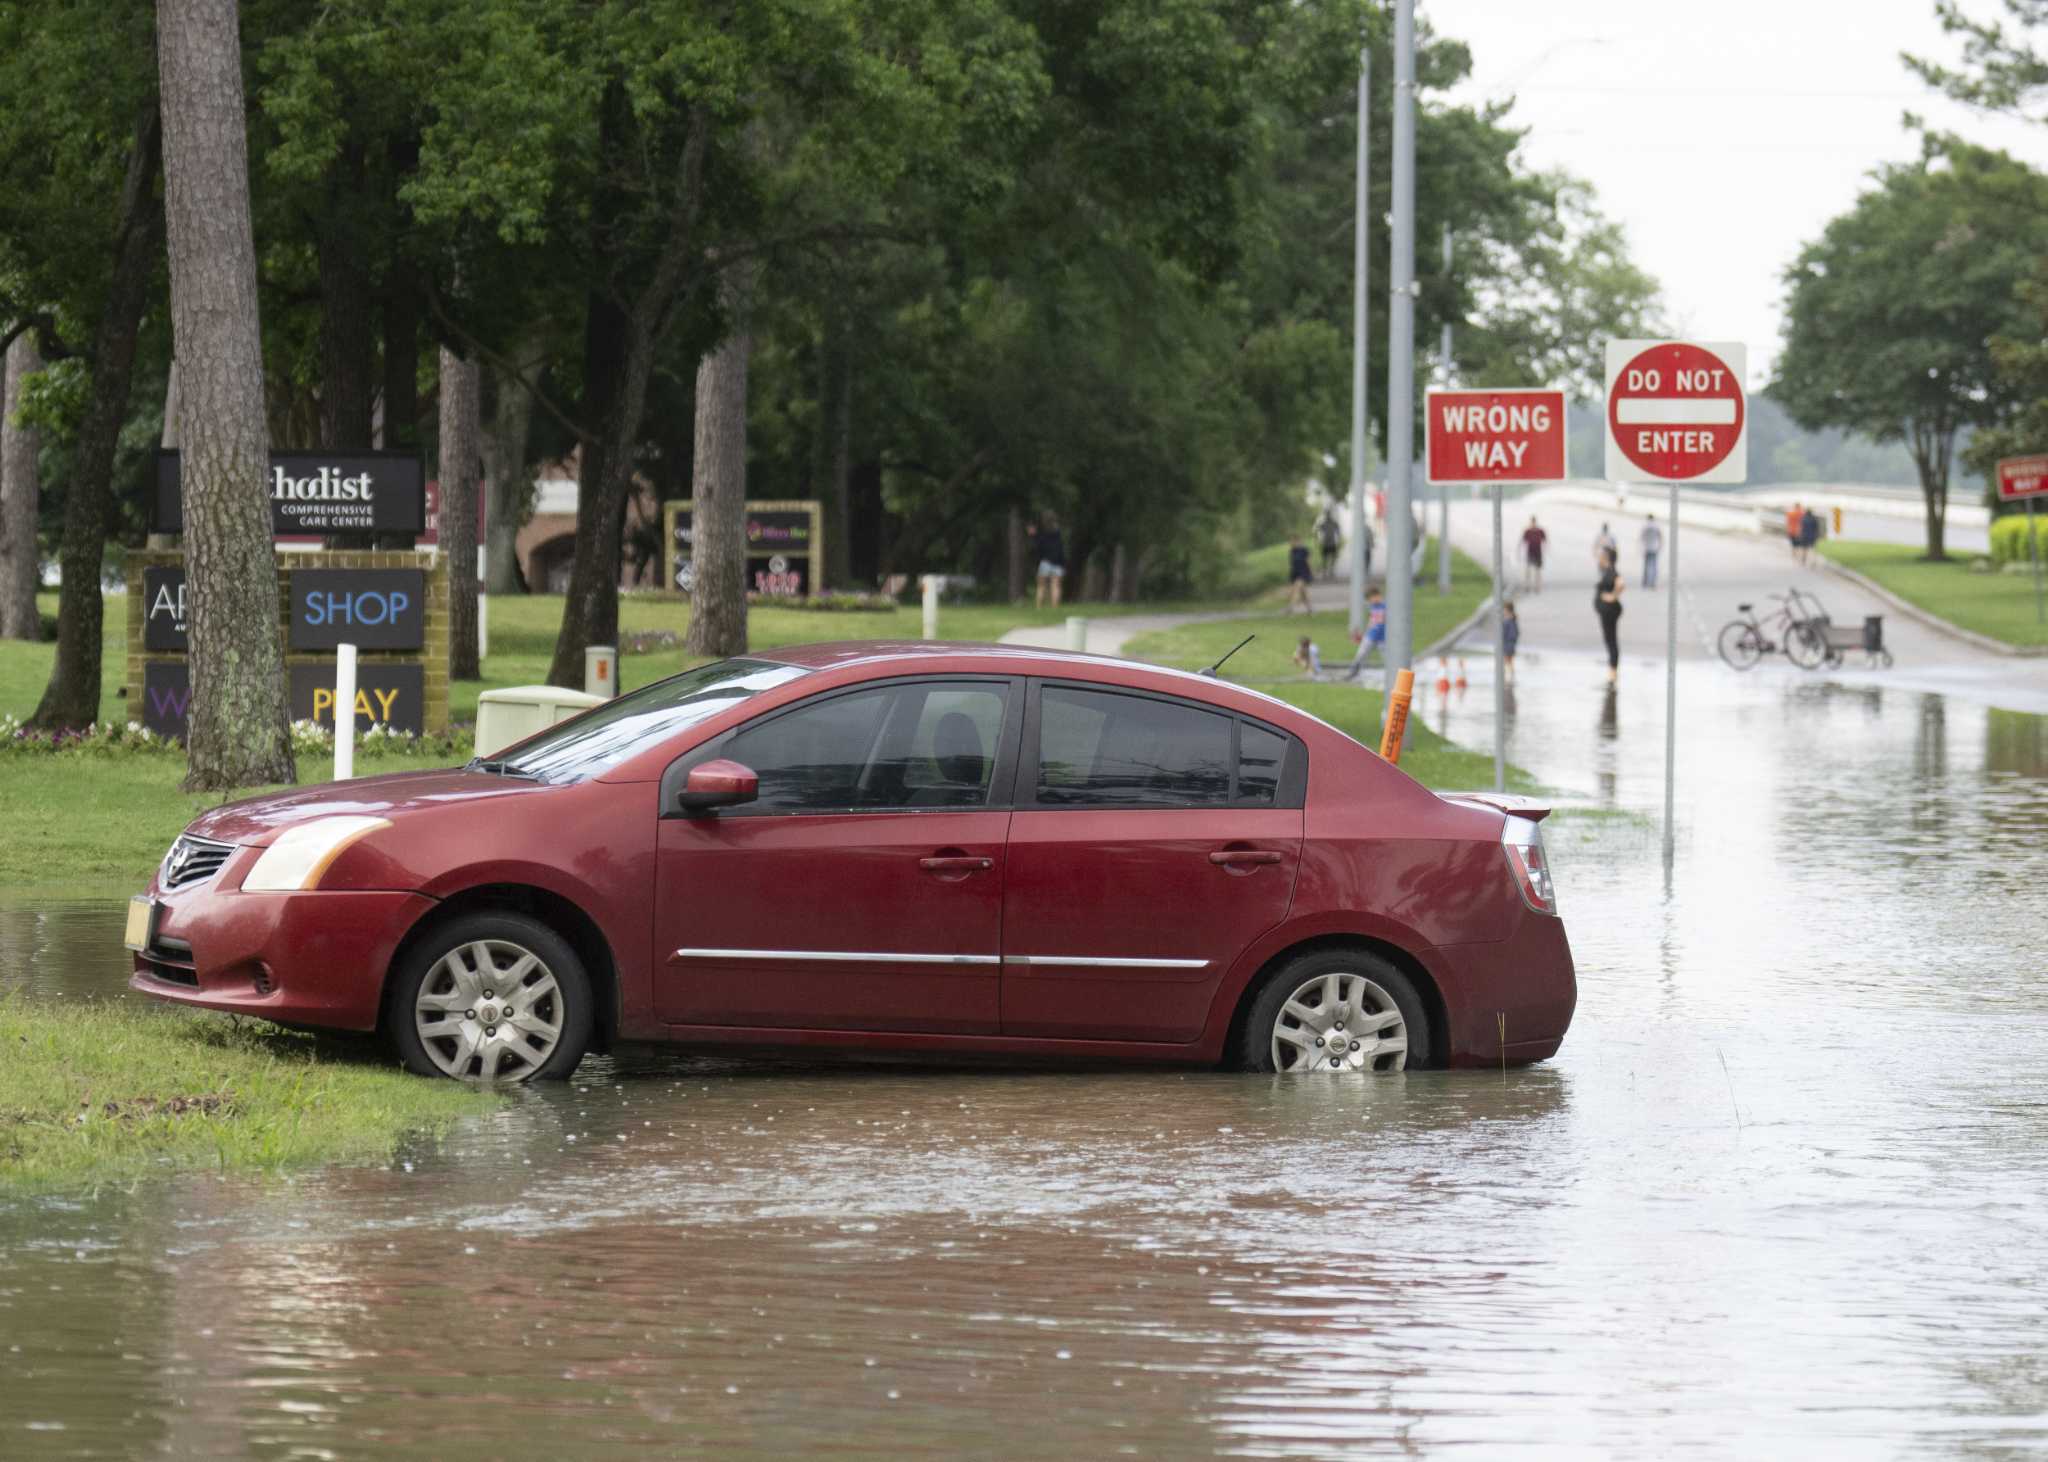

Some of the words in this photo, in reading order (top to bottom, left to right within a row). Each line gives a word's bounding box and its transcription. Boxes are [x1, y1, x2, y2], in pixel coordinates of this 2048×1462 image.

[1628, 369, 1661, 392] DO
[1676, 369, 1724, 392] NOT
[1443, 404, 1551, 433] WRONG
[1637, 431, 1714, 453] ENTER
[1464, 440, 1529, 468] WAY
[281, 505, 373, 515] COMPREHENSIVE
[299, 516, 327, 527] CARE
[331, 516, 373, 527] CENTER
[304, 591, 409, 625] SHOP
